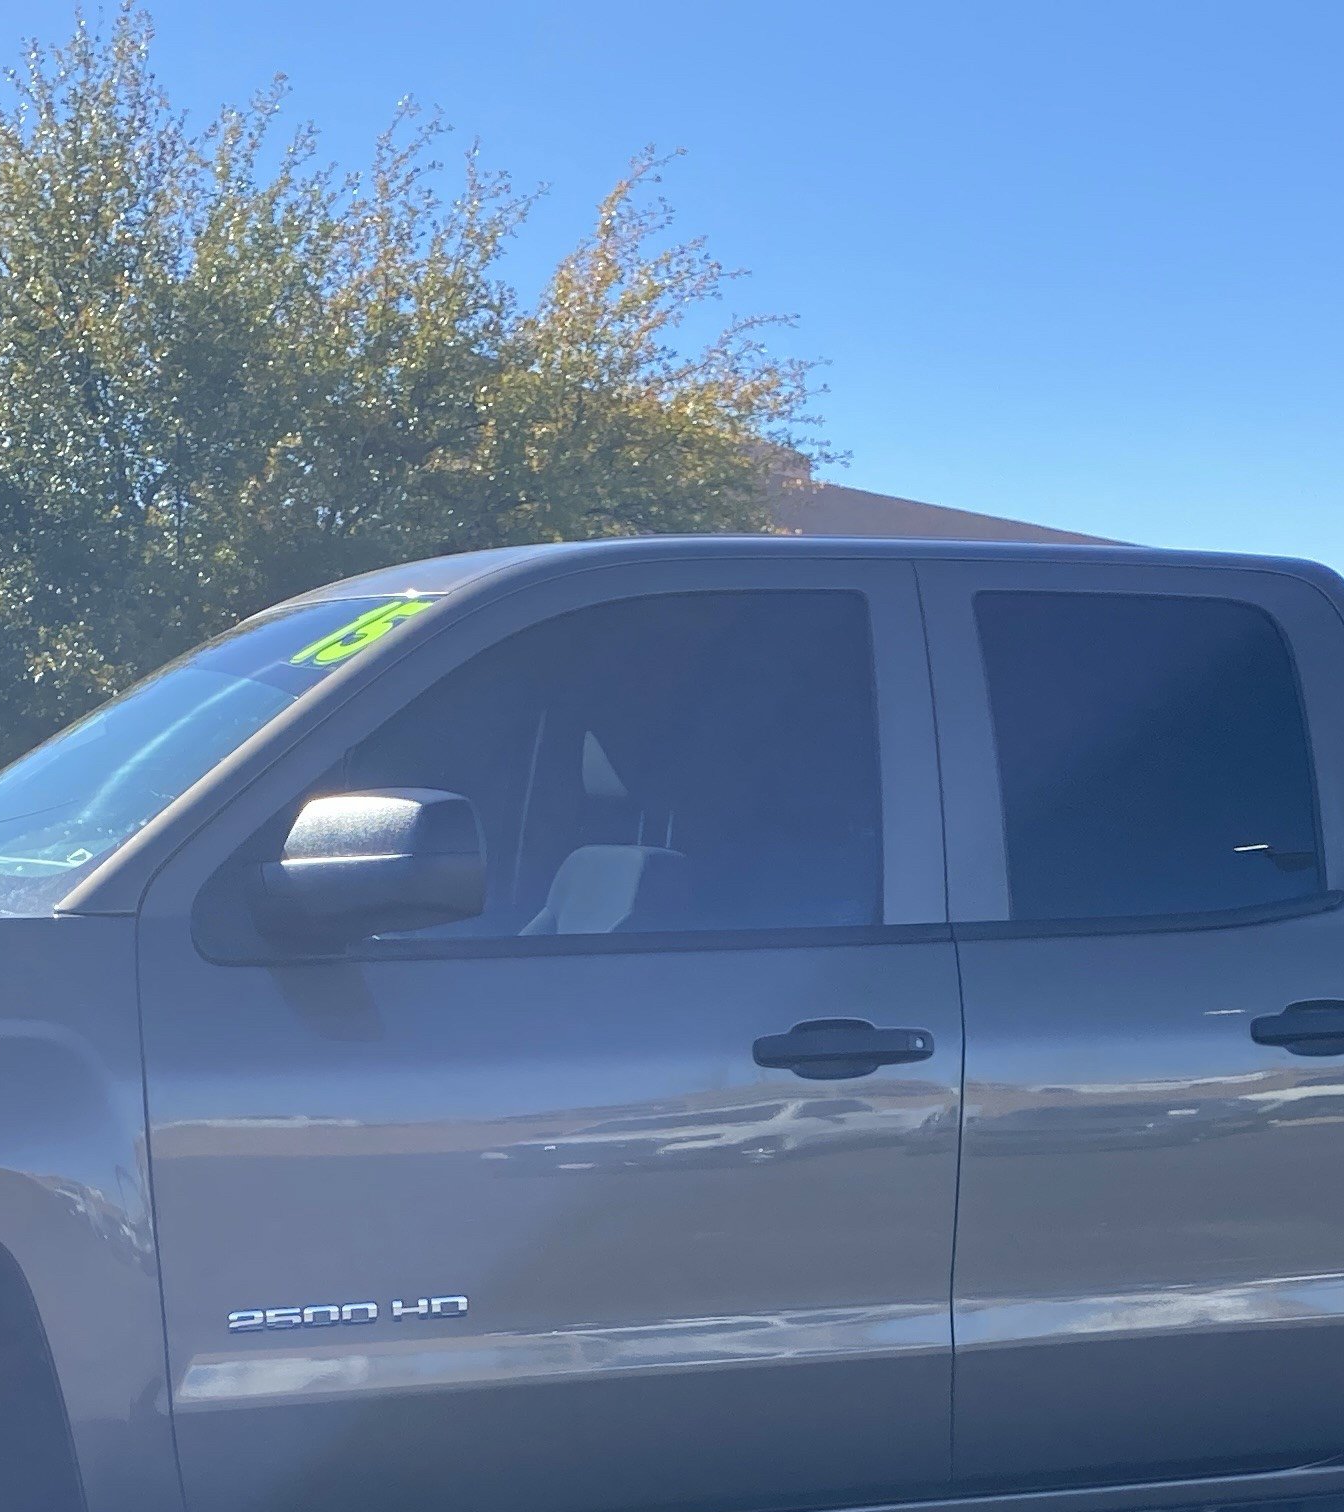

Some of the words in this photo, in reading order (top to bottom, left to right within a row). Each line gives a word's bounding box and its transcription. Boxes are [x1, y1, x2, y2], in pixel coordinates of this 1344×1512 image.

[289, 598, 434, 666] 15
[227, 1301, 378, 1334] 2500
[391, 1294, 469, 1322] HD
